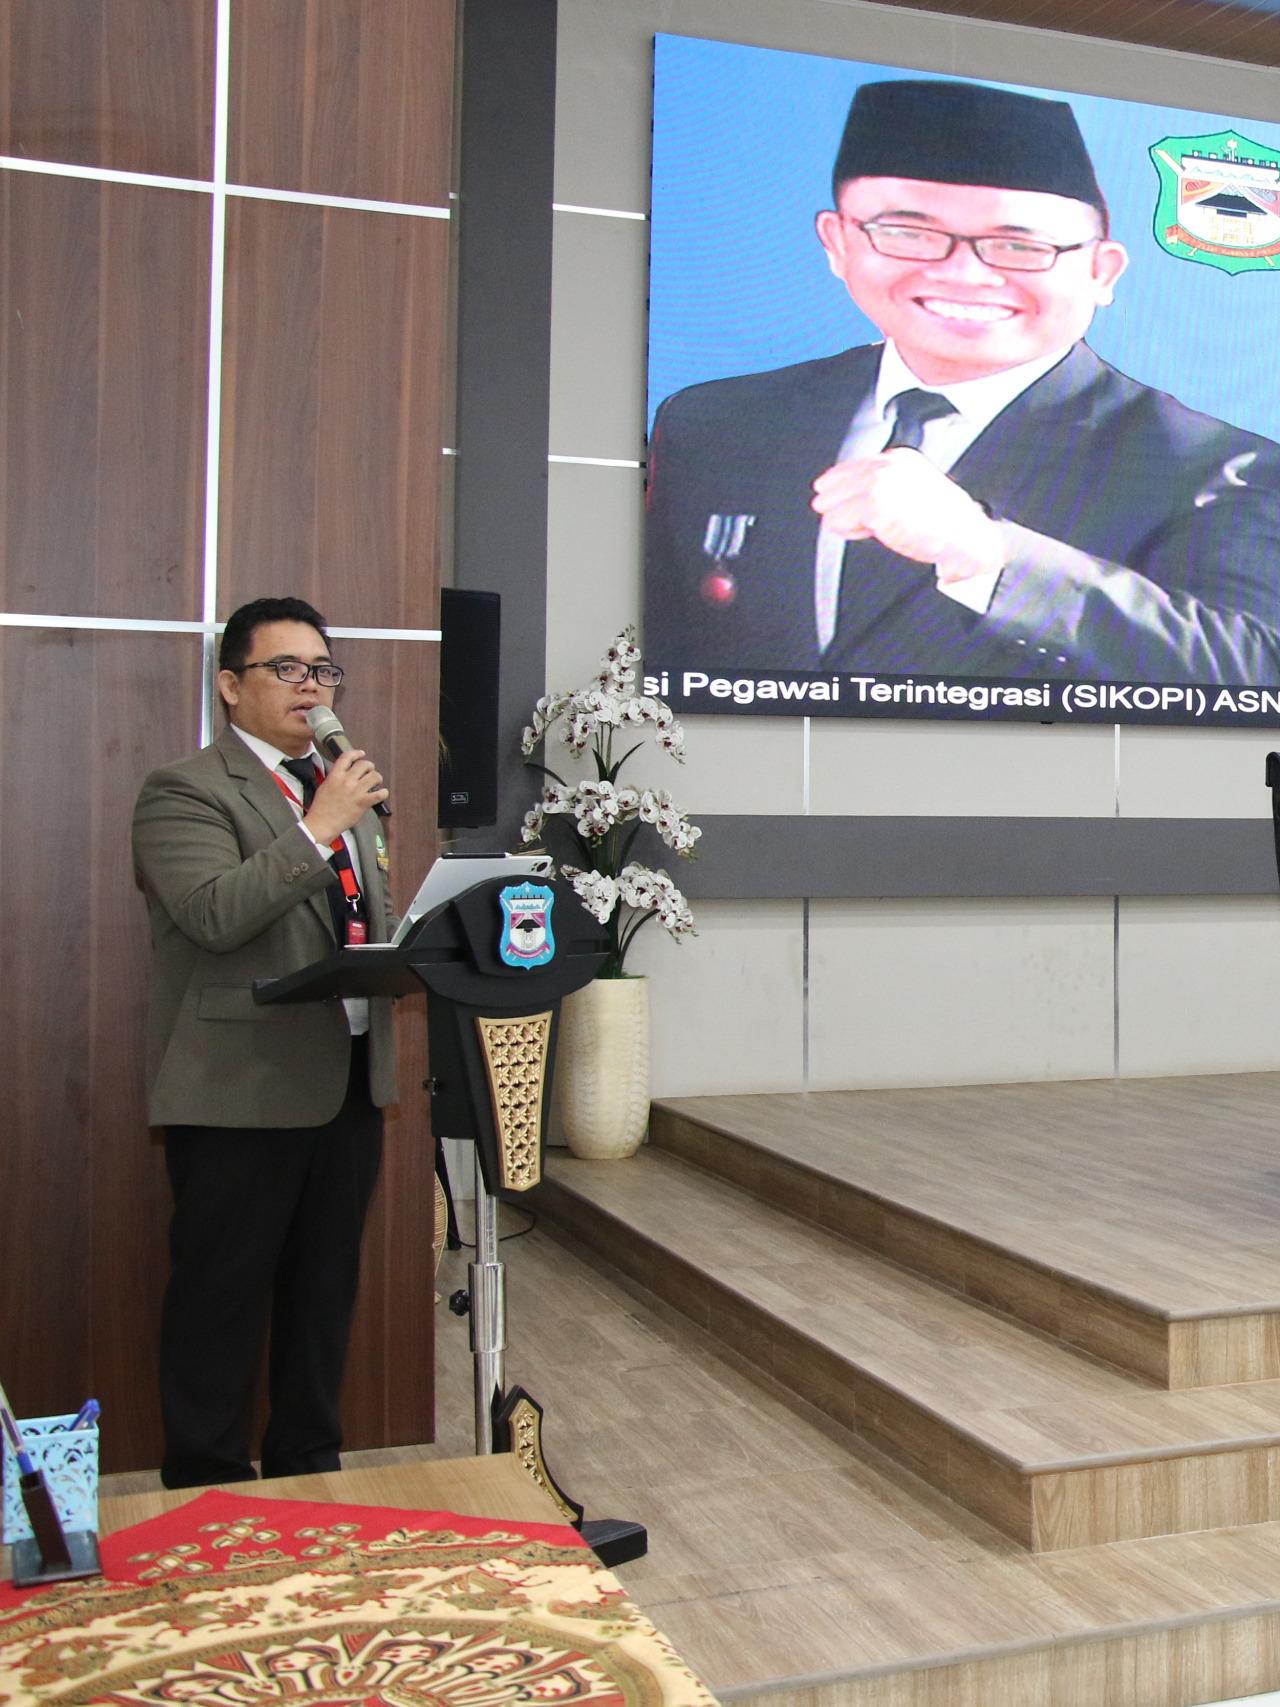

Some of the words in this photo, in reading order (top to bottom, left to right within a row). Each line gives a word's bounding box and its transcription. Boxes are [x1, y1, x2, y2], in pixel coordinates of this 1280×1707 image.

[683, 672, 840, 703] Pegawai
[851, 677, 1051, 709] Terintegrasi
[1061, 683, 1206, 715] (SIKOPI)
